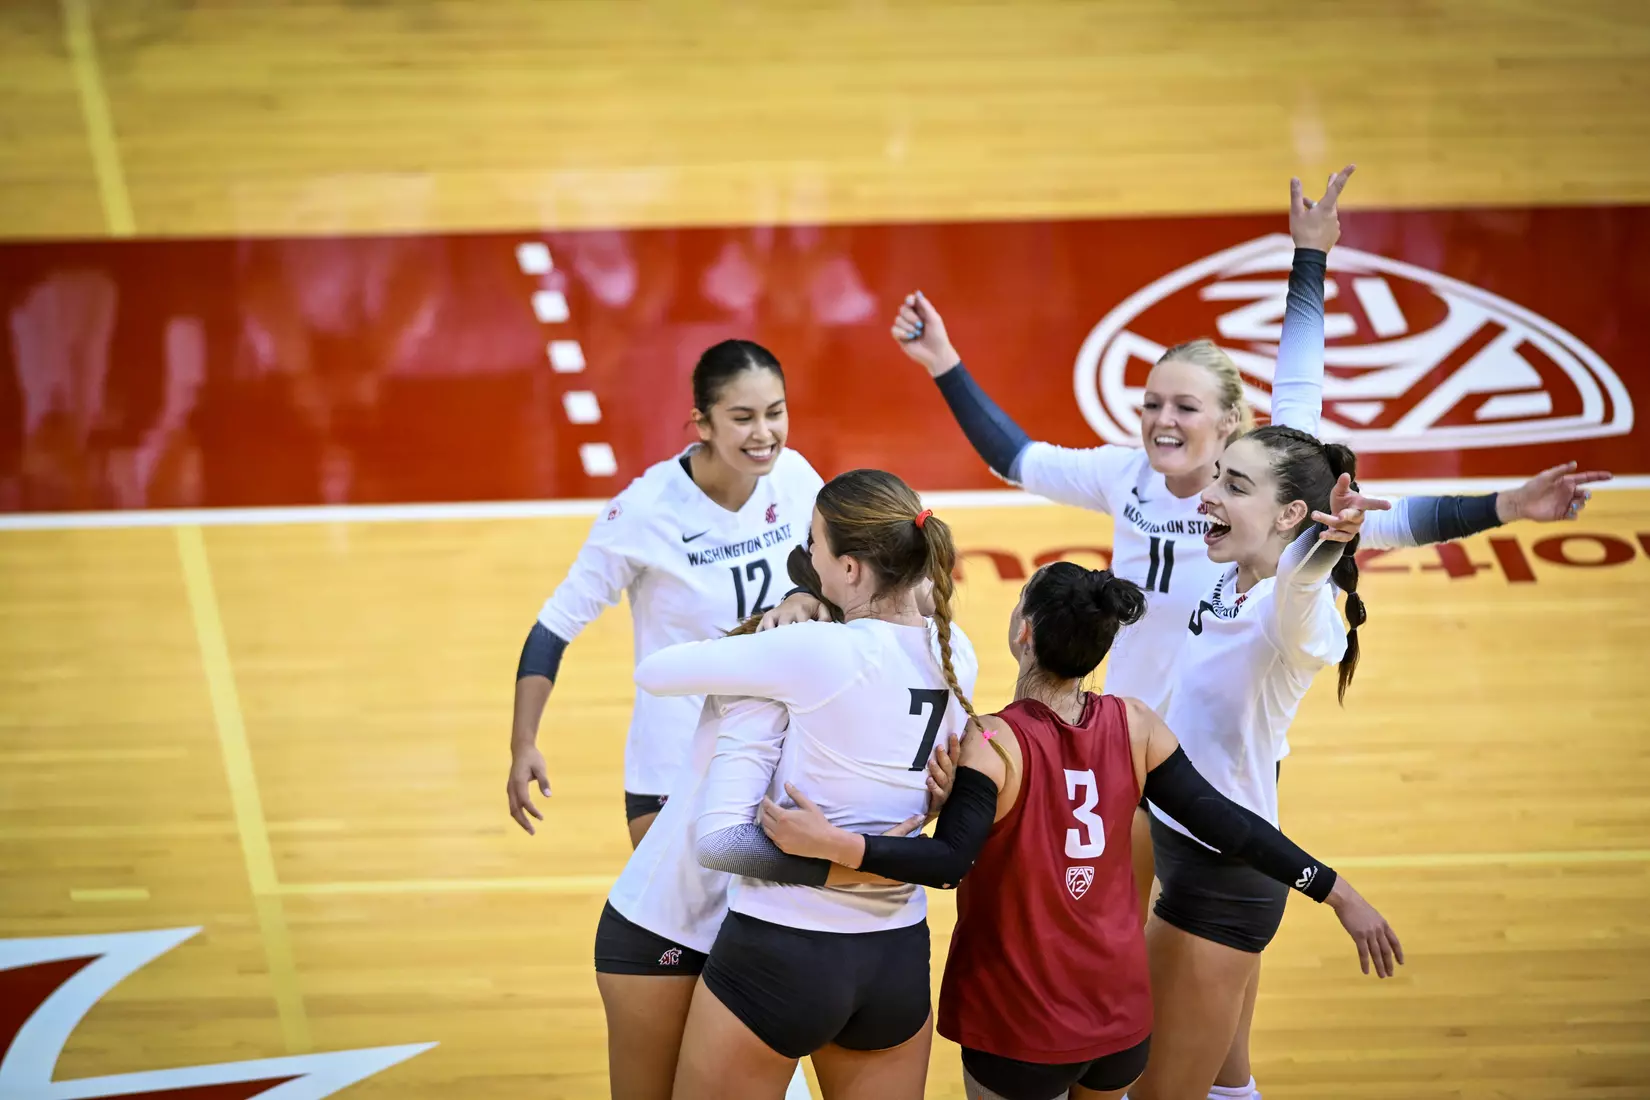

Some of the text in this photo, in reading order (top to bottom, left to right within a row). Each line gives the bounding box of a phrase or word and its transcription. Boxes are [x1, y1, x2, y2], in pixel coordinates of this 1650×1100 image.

[687, 523, 792, 567] WASHINGTON STATE
[1145, 536, 1175, 594] 11
[729, 558, 775, 622] 12
[908, 689, 950, 772] 7
[1064, 769, 1106, 859] 3
[1071, 880, 1086, 892] 12
